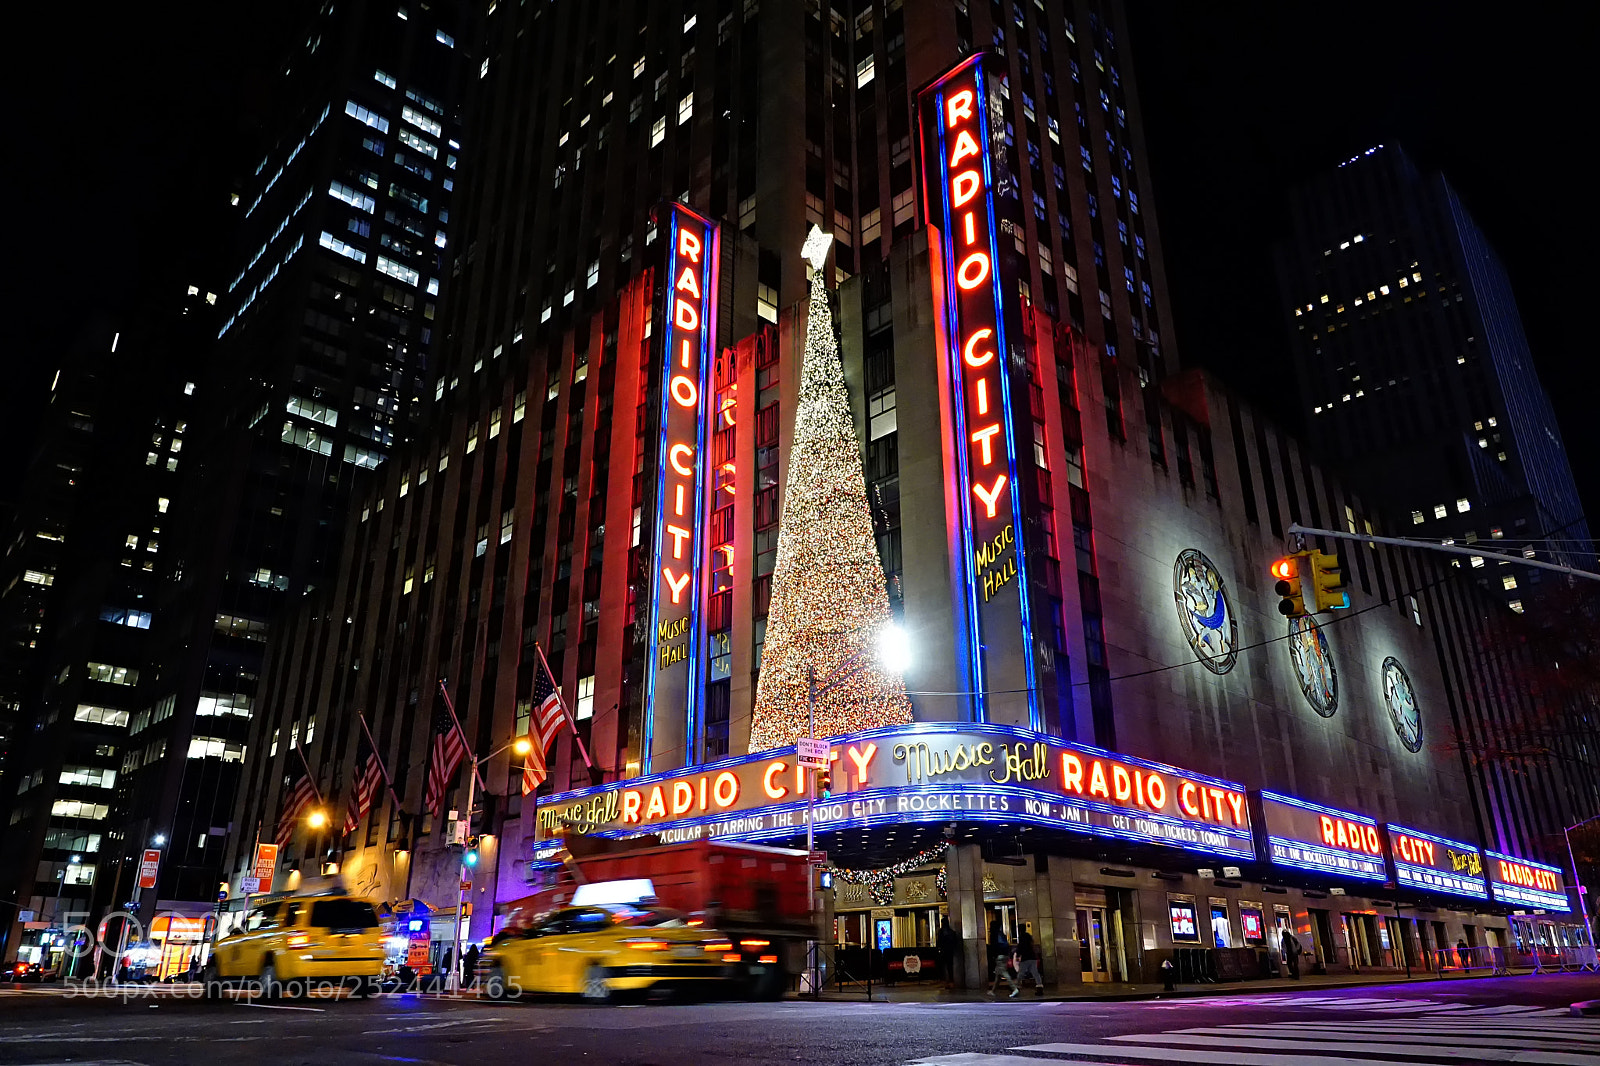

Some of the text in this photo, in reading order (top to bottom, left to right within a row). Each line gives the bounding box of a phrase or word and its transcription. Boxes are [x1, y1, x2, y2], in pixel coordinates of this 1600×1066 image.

[947, 89, 1007, 519] RADIO CITY
[662, 228, 701, 605] RADIO CITY
[974, 524, 1014, 577] MUSIC
[984, 557, 1017, 602] HALL
[658, 616, 689, 643] MUSIC
[660, 643, 688, 670] HALL
[893, 741, 1051, 784] Music Hall
[623, 743, 877, 824] RADIO CIY
[1062, 752, 1243, 825] RADIO CITY
[709, 816, 763, 837] STARRING
[771, 812, 794, 829] THE
[803, 805, 843, 824] RADIO
[852, 799, 886, 818] CITY
[898, 794, 1009, 812] ROCKETTES
[1025, 799, 1050, 817] NOW
[1060, 806, 1081, 823] JAN
[1112, 815, 1229, 848] GET YOUR TICKETS TODAY!
[1320, 815, 1380, 854] RADIO
[1399, 834, 1435, 866] CITY
[1274, 845, 1287, 857] SEE
[1289, 847, 1301, 861] THE
[1303, 850, 1337, 867] ROCKETTES
[1500, 860, 1535, 887] RADIO
[1534, 869, 1557, 891] CITY
